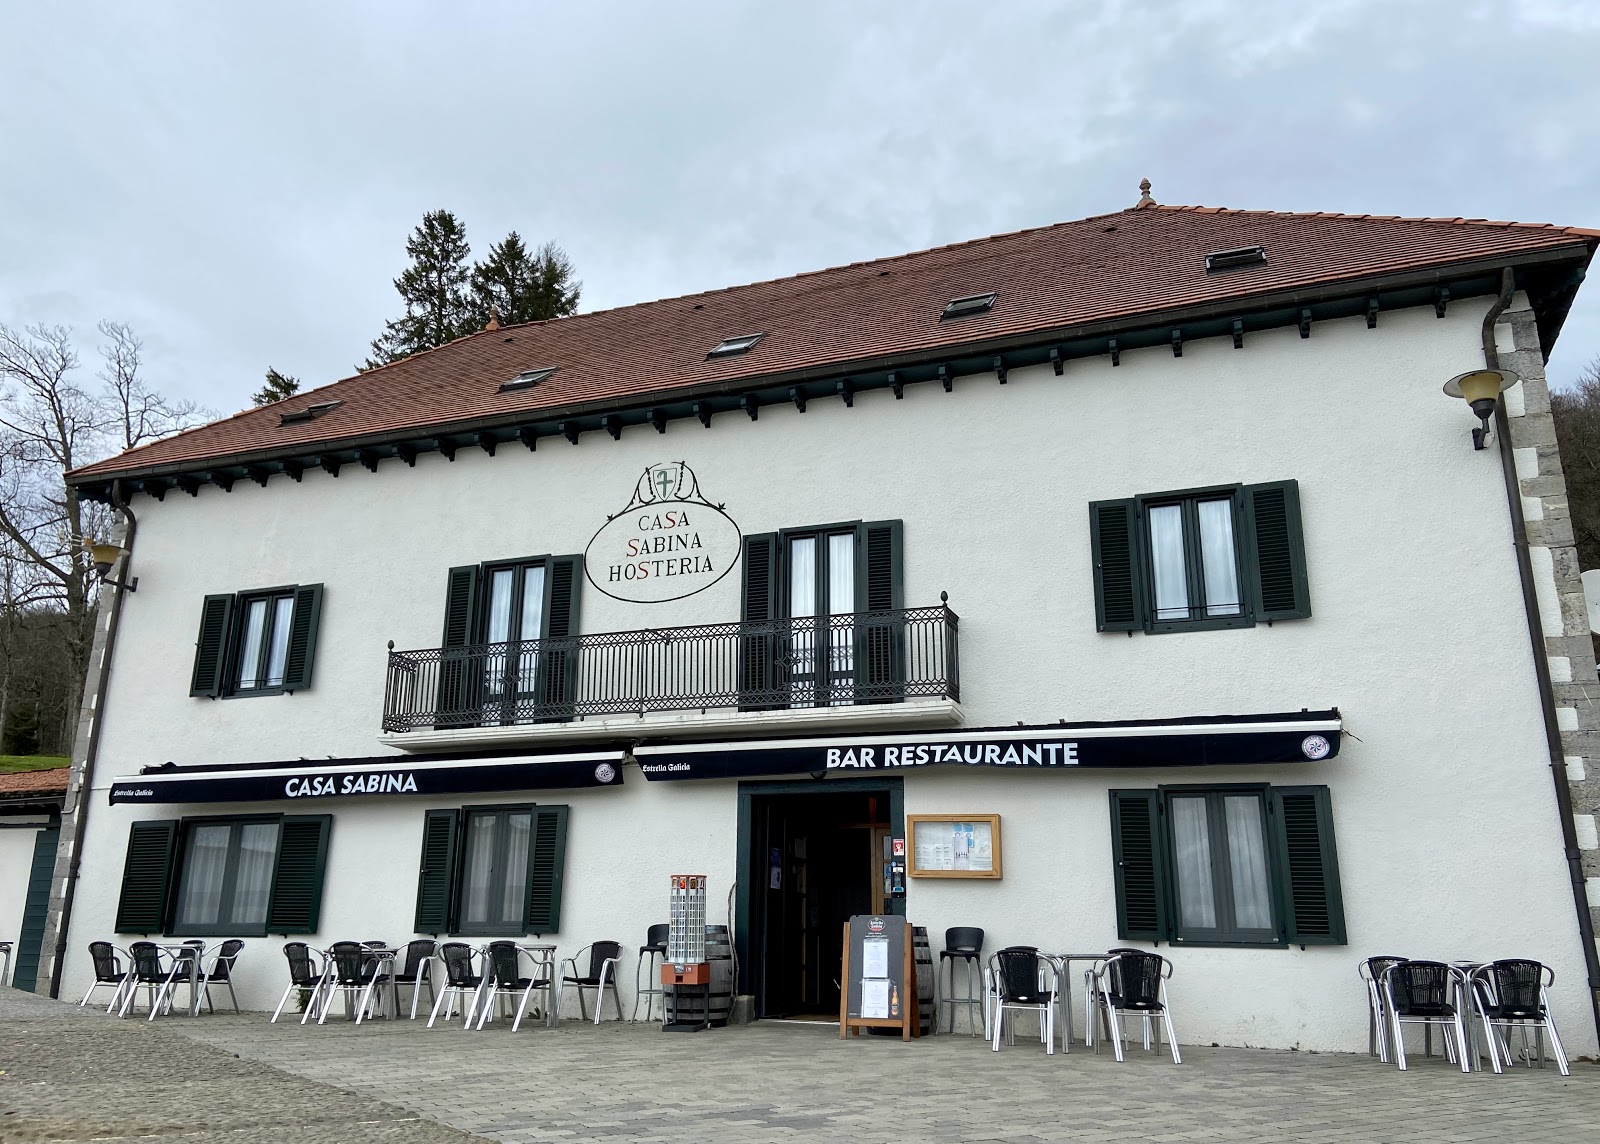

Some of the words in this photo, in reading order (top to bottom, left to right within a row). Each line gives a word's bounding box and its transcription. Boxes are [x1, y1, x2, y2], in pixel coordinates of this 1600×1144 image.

[638, 511, 690, 531] CASA
[626, 532, 703, 558] SABINA
[608, 555, 714, 582] HOSTERIA
[642, 764, 667, 772] Estrella
[667, 762, 691, 771] Galicia
[826, 748, 876, 768] BAR
[884, 743, 1079, 767] RESTAURANTE
[285, 775, 336, 797] CASA
[340, 773, 418, 795] SABINA
